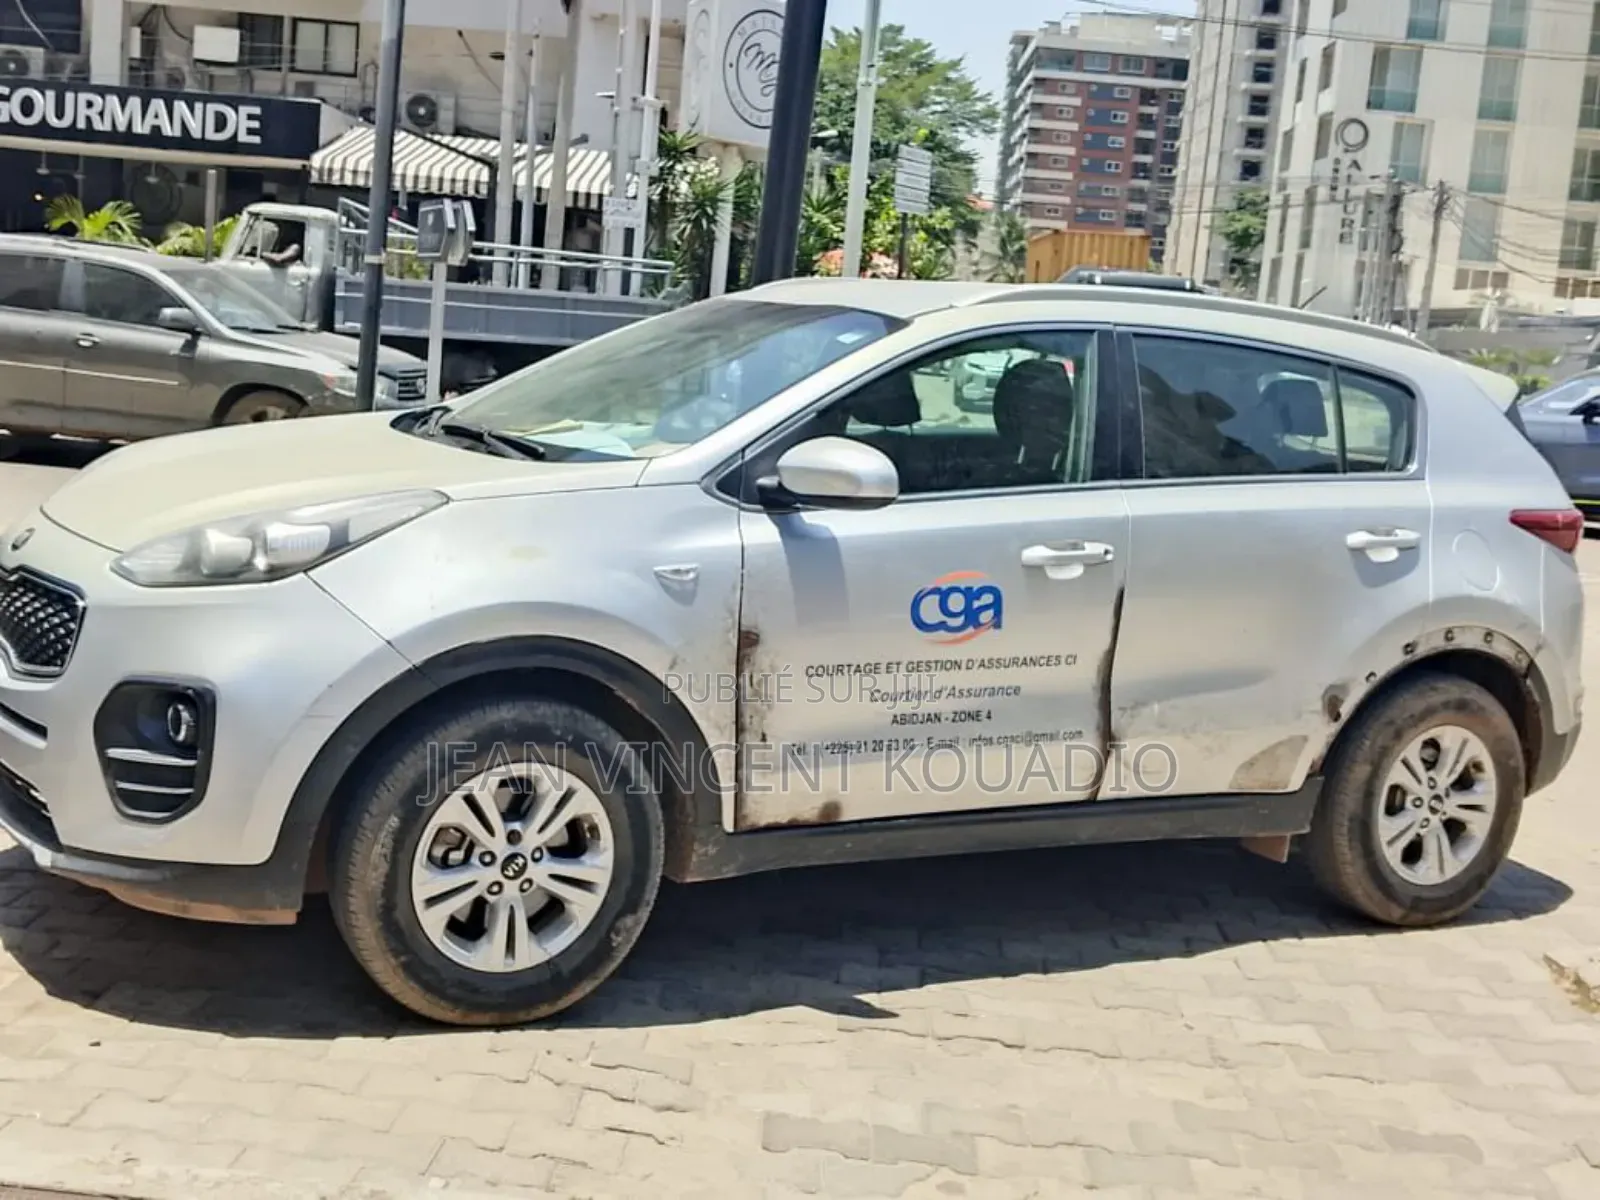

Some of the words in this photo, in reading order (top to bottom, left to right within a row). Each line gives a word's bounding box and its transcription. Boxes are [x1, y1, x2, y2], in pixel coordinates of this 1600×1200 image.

[910, 585, 1003, 633] cga
[805, 662, 881, 678] COURTAGE
[886, 661, 901, 674] ET
[906, 658, 962, 673] GESTION
[965, 655, 1061, 671] D'ASSURANCES
[1064, 654, 1078, 666] CI
[869, 687, 927, 703] Courtier
[933, 684, 1021, 700] d'Assurance
[891, 712, 943, 726] ABIDJAN
[951, 710, 982, 724] ZONE
[984, 710, 992, 721] 4
